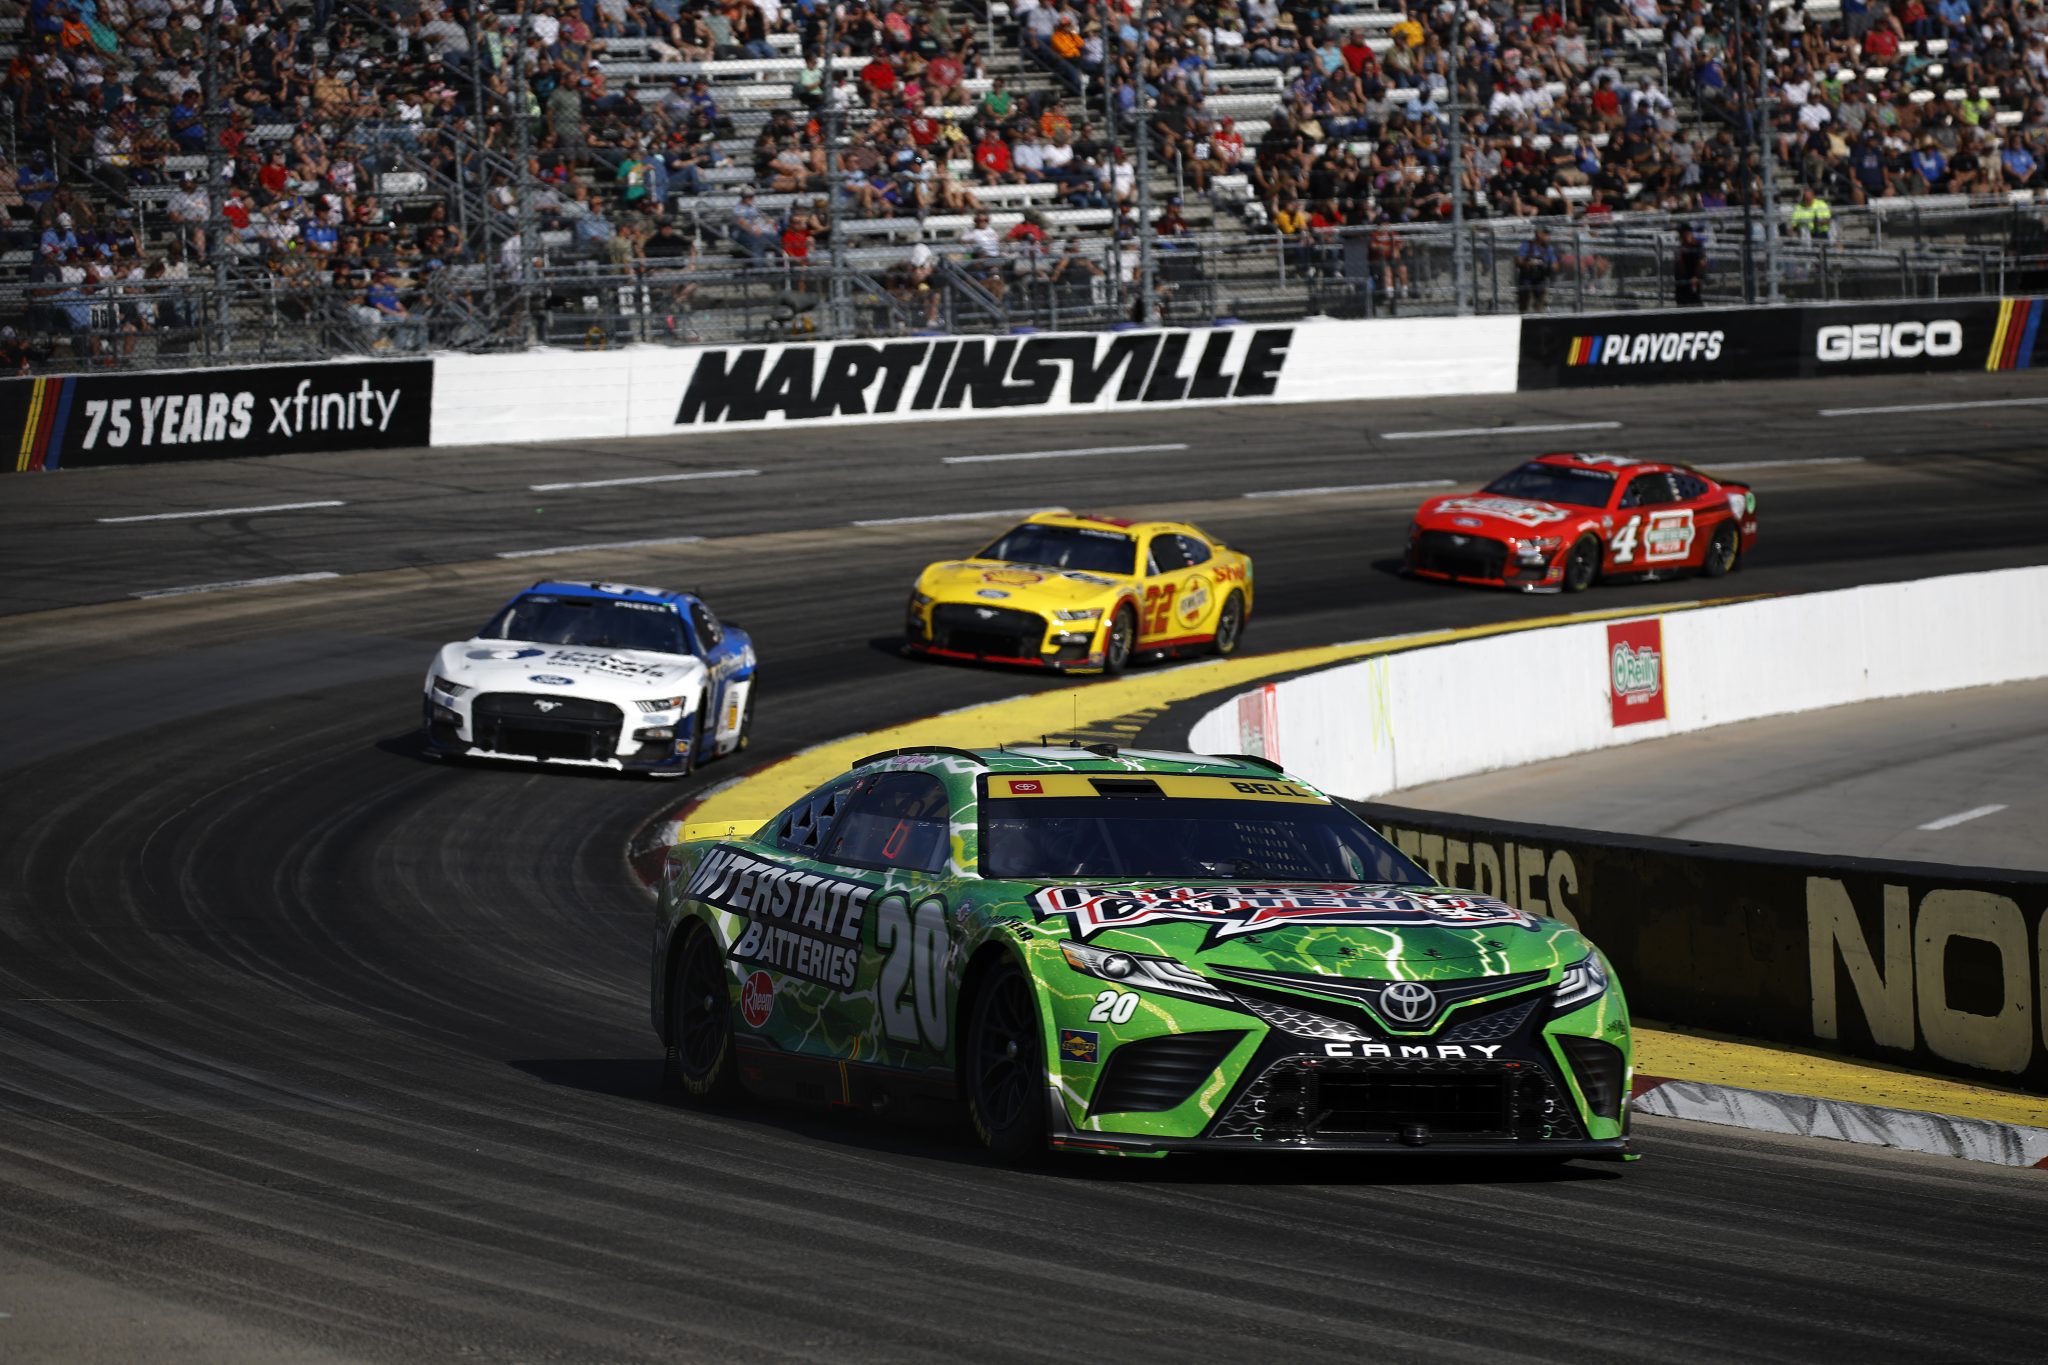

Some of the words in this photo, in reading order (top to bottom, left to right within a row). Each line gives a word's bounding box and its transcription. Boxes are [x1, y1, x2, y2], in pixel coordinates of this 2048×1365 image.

[1602, 330, 1724, 365] PLAYOFFS
[1817, 320, 1962, 361] GEICO
[674, 327, 1296, 426] MARTINSVILLE
[82, 399, 131, 449] 75
[140, 392, 255, 446] YEARS
[268, 379, 401, 437] xfinity
[1611, 514, 1643, 563] 4
[1141, 583, 1176, 635] 22
[1230, 782, 1309, 797] BELL
[686, 849, 875, 941] INTERSTATE
[1383, 825, 1581, 931] TERIES
[733, 921, 859, 989] BATTERIES
[877, 896, 949, 1048] 20
[1805, 876, 2048, 1074] NO
[744, 972, 773, 1018] Rheem
[1088, 989, 1141, 1024] 20
[1324, 1043, 1502, 1059] CAMRY
